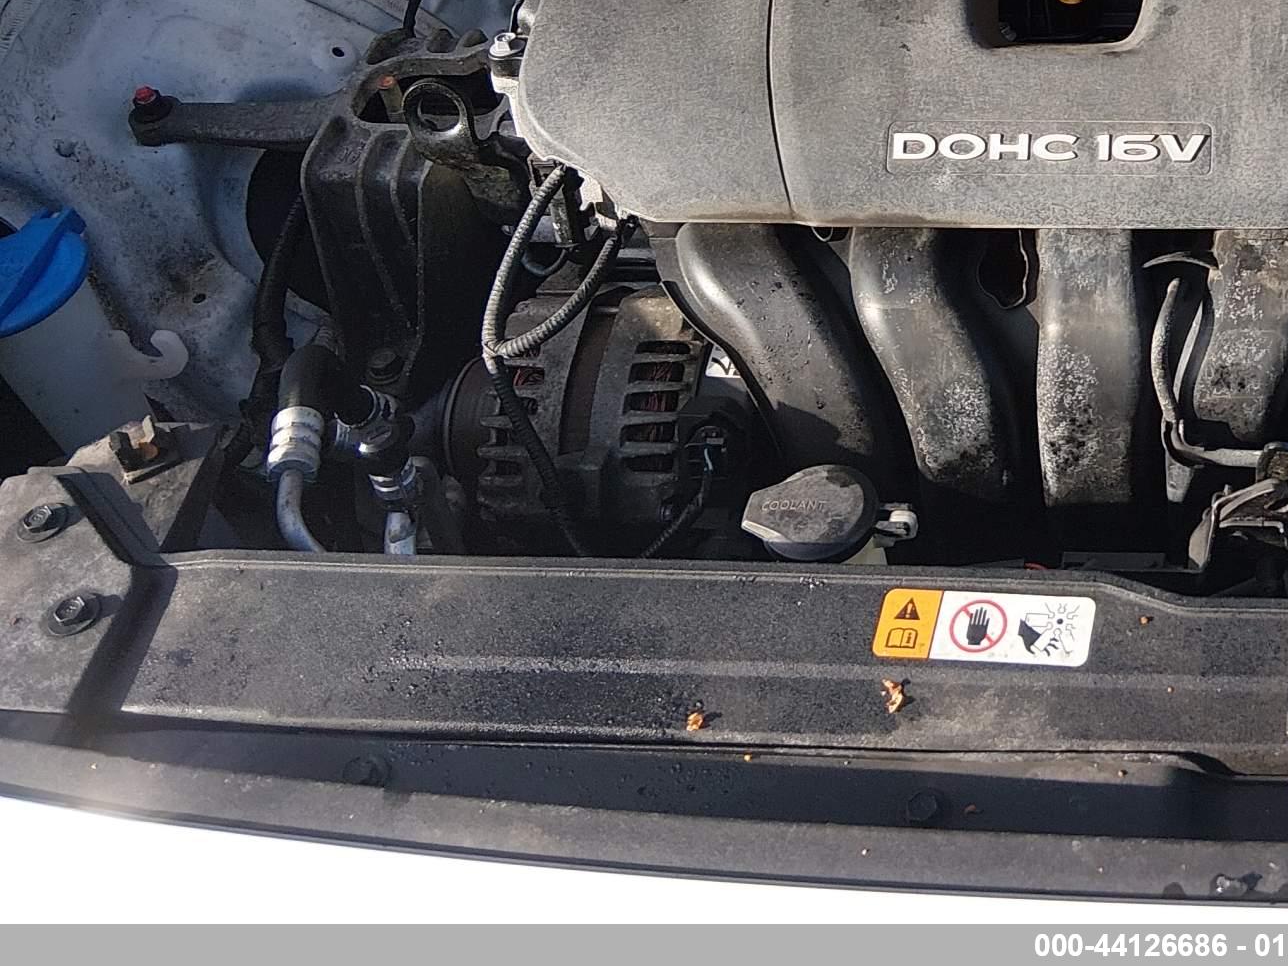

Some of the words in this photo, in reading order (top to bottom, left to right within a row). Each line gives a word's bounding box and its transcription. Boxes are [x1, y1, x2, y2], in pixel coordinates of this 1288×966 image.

[892, 133, 1081, 161] DOHC
[1098, 134, 1210, 162] 16V
[761, 499, 829, 511] COOLANT
